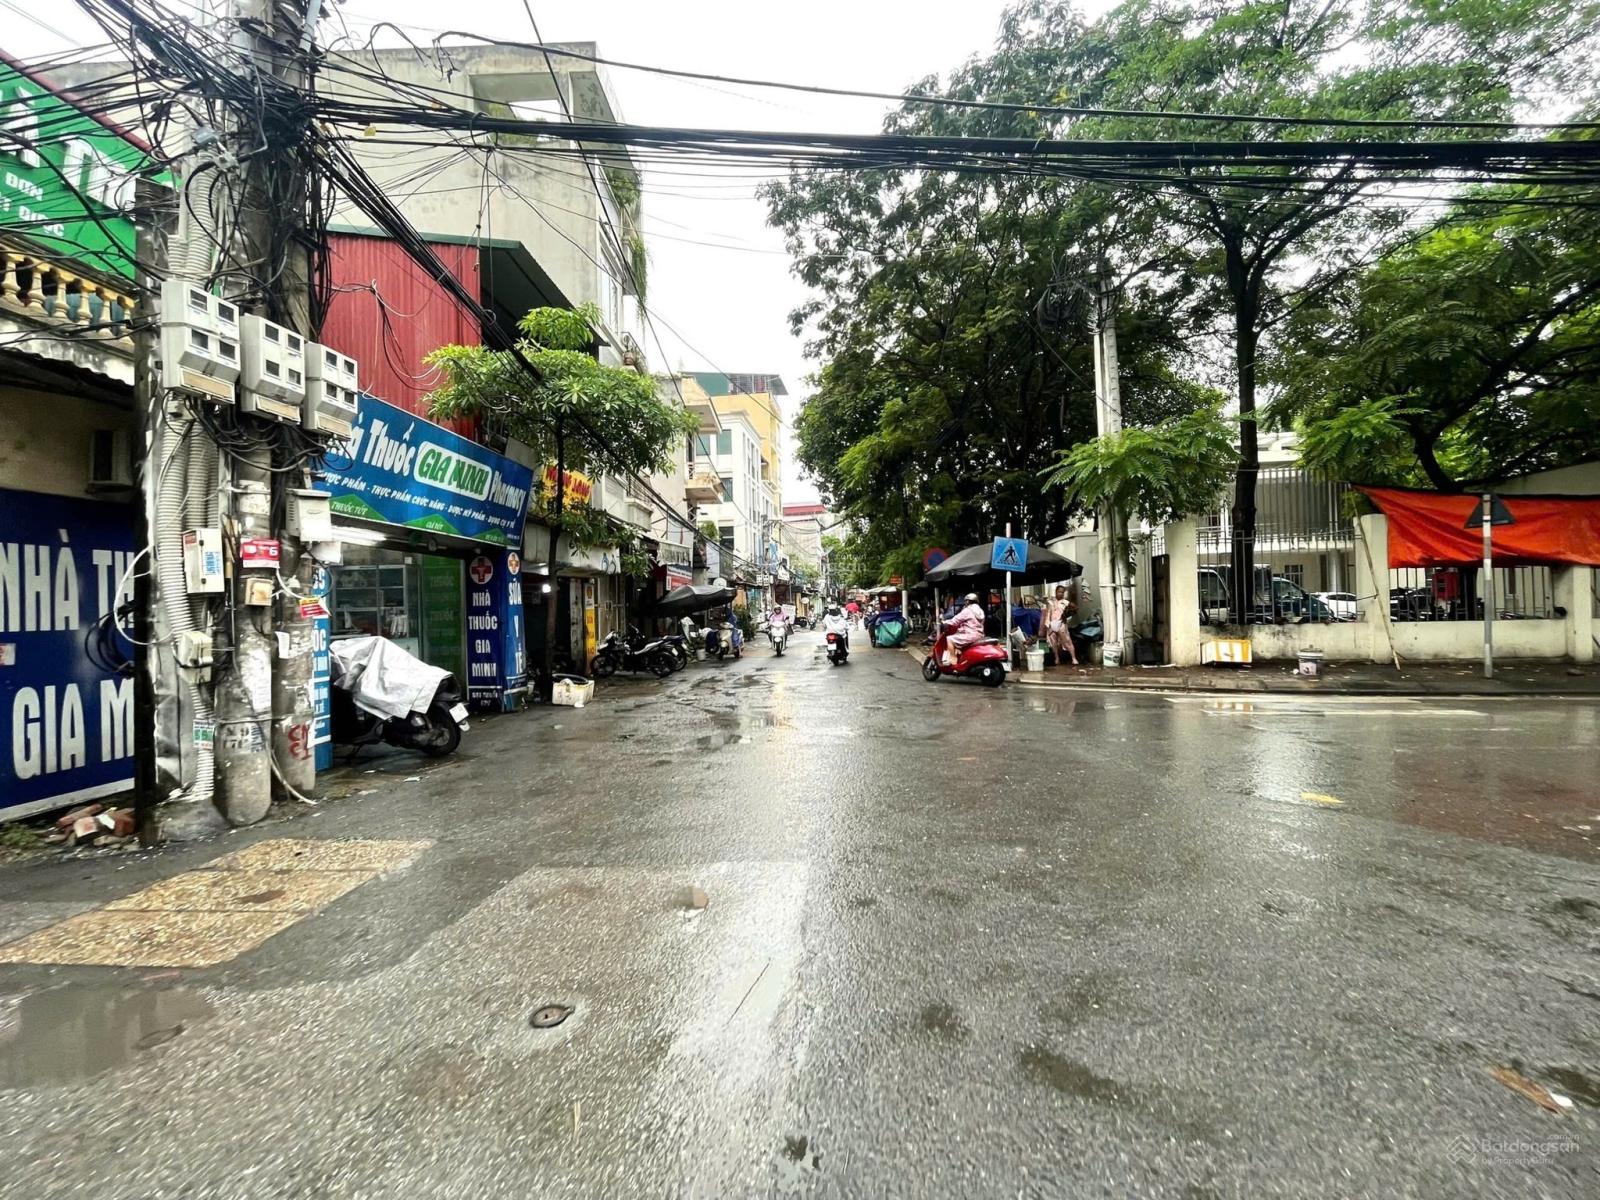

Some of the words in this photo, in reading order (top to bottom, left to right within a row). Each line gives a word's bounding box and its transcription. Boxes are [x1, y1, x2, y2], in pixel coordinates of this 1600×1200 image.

[363, 418, 416, 476] Thuốc
[418, 448, 452, 484] GIA
[448, 459, 490, 495] MINH
[0, 528, 80, 632] NHÀ
[472, 589, 491, 606] NHÀ
[468, 610, 498, 630] THUỐC
[475, 639, 491, 654] GIA
[471, 662, 497, 677] MINH
[12, 683, 86, 780] GIA
